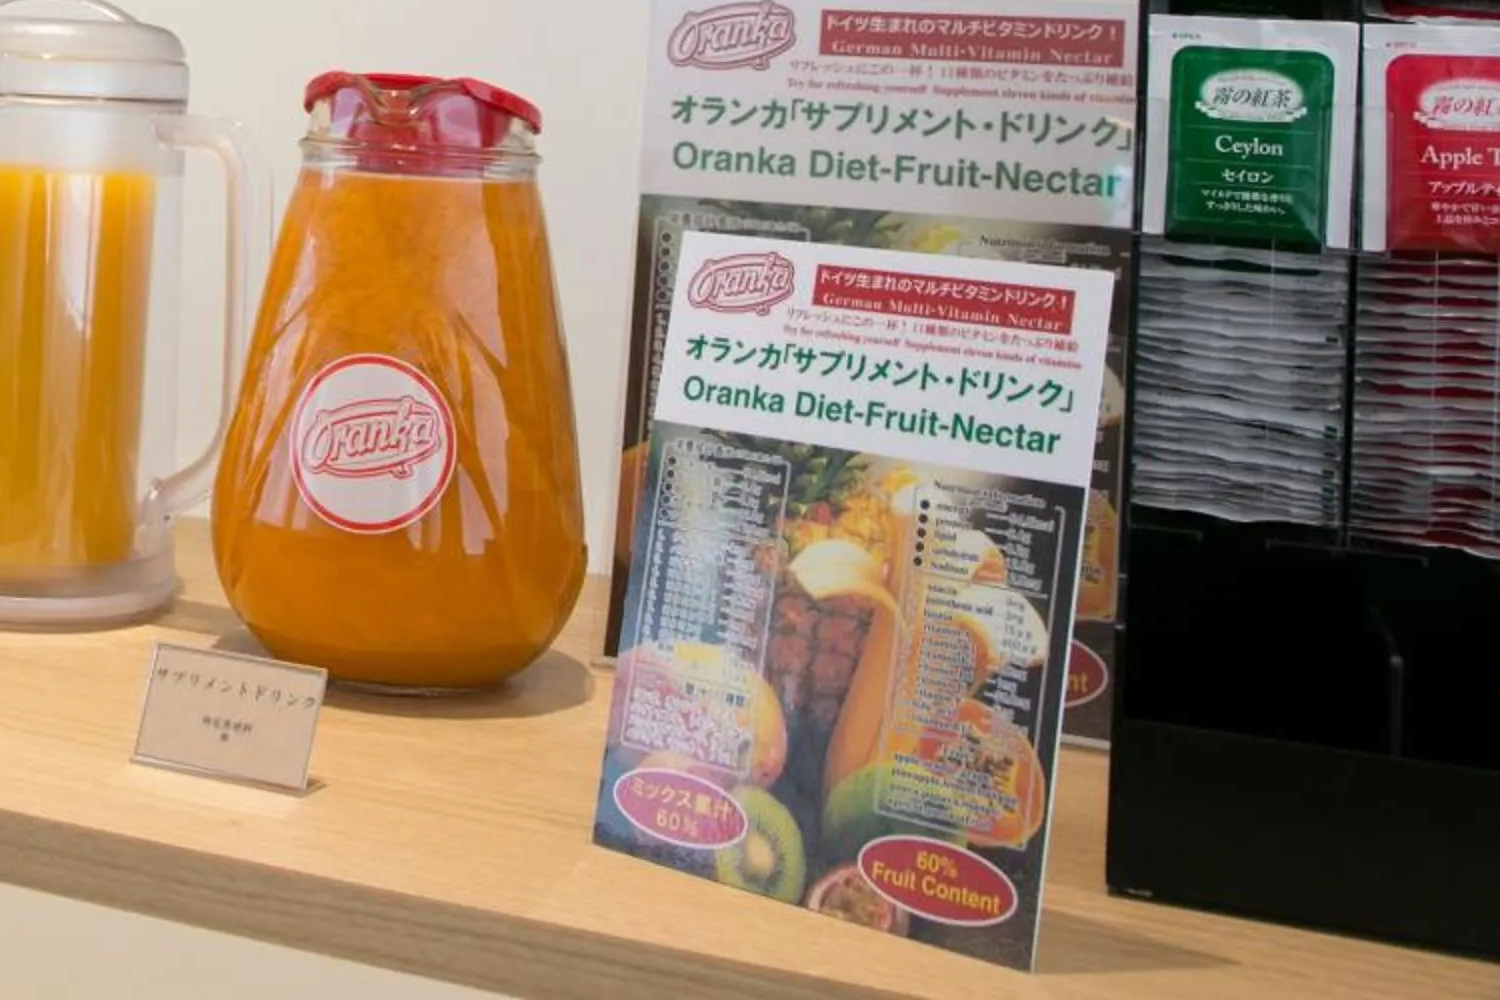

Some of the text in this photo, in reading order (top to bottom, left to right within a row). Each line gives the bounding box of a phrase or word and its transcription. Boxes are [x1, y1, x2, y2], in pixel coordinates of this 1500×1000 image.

[668, 0, 796, 70] Oranka
[831, 40, 1113, 65] German Multi-Vitamin Nectar
[1432, 95, 1500, 117] 霧の紅
[1215, 134, 1284, 159] Ceylon
[1420, 145, 1483, 170] Apple
[672, 141, 1122, 198] Oranka Diet-Fruit-Nectar
[1222, 168, 1275, 184] セイロン
[687, 251, 795, 316] Oranka
[822, 293, 1065, 332] German Multi-Vitamin Nectar
[683, 375, 785, 414] Oranka
[794, 390, 1061, 454] Diet-Fruit-Nectar
[301, 395, 441, 478] Oranka
[916, 850, 959, 879] 60%
[871, 861, 1001, 914] Fruit Content
